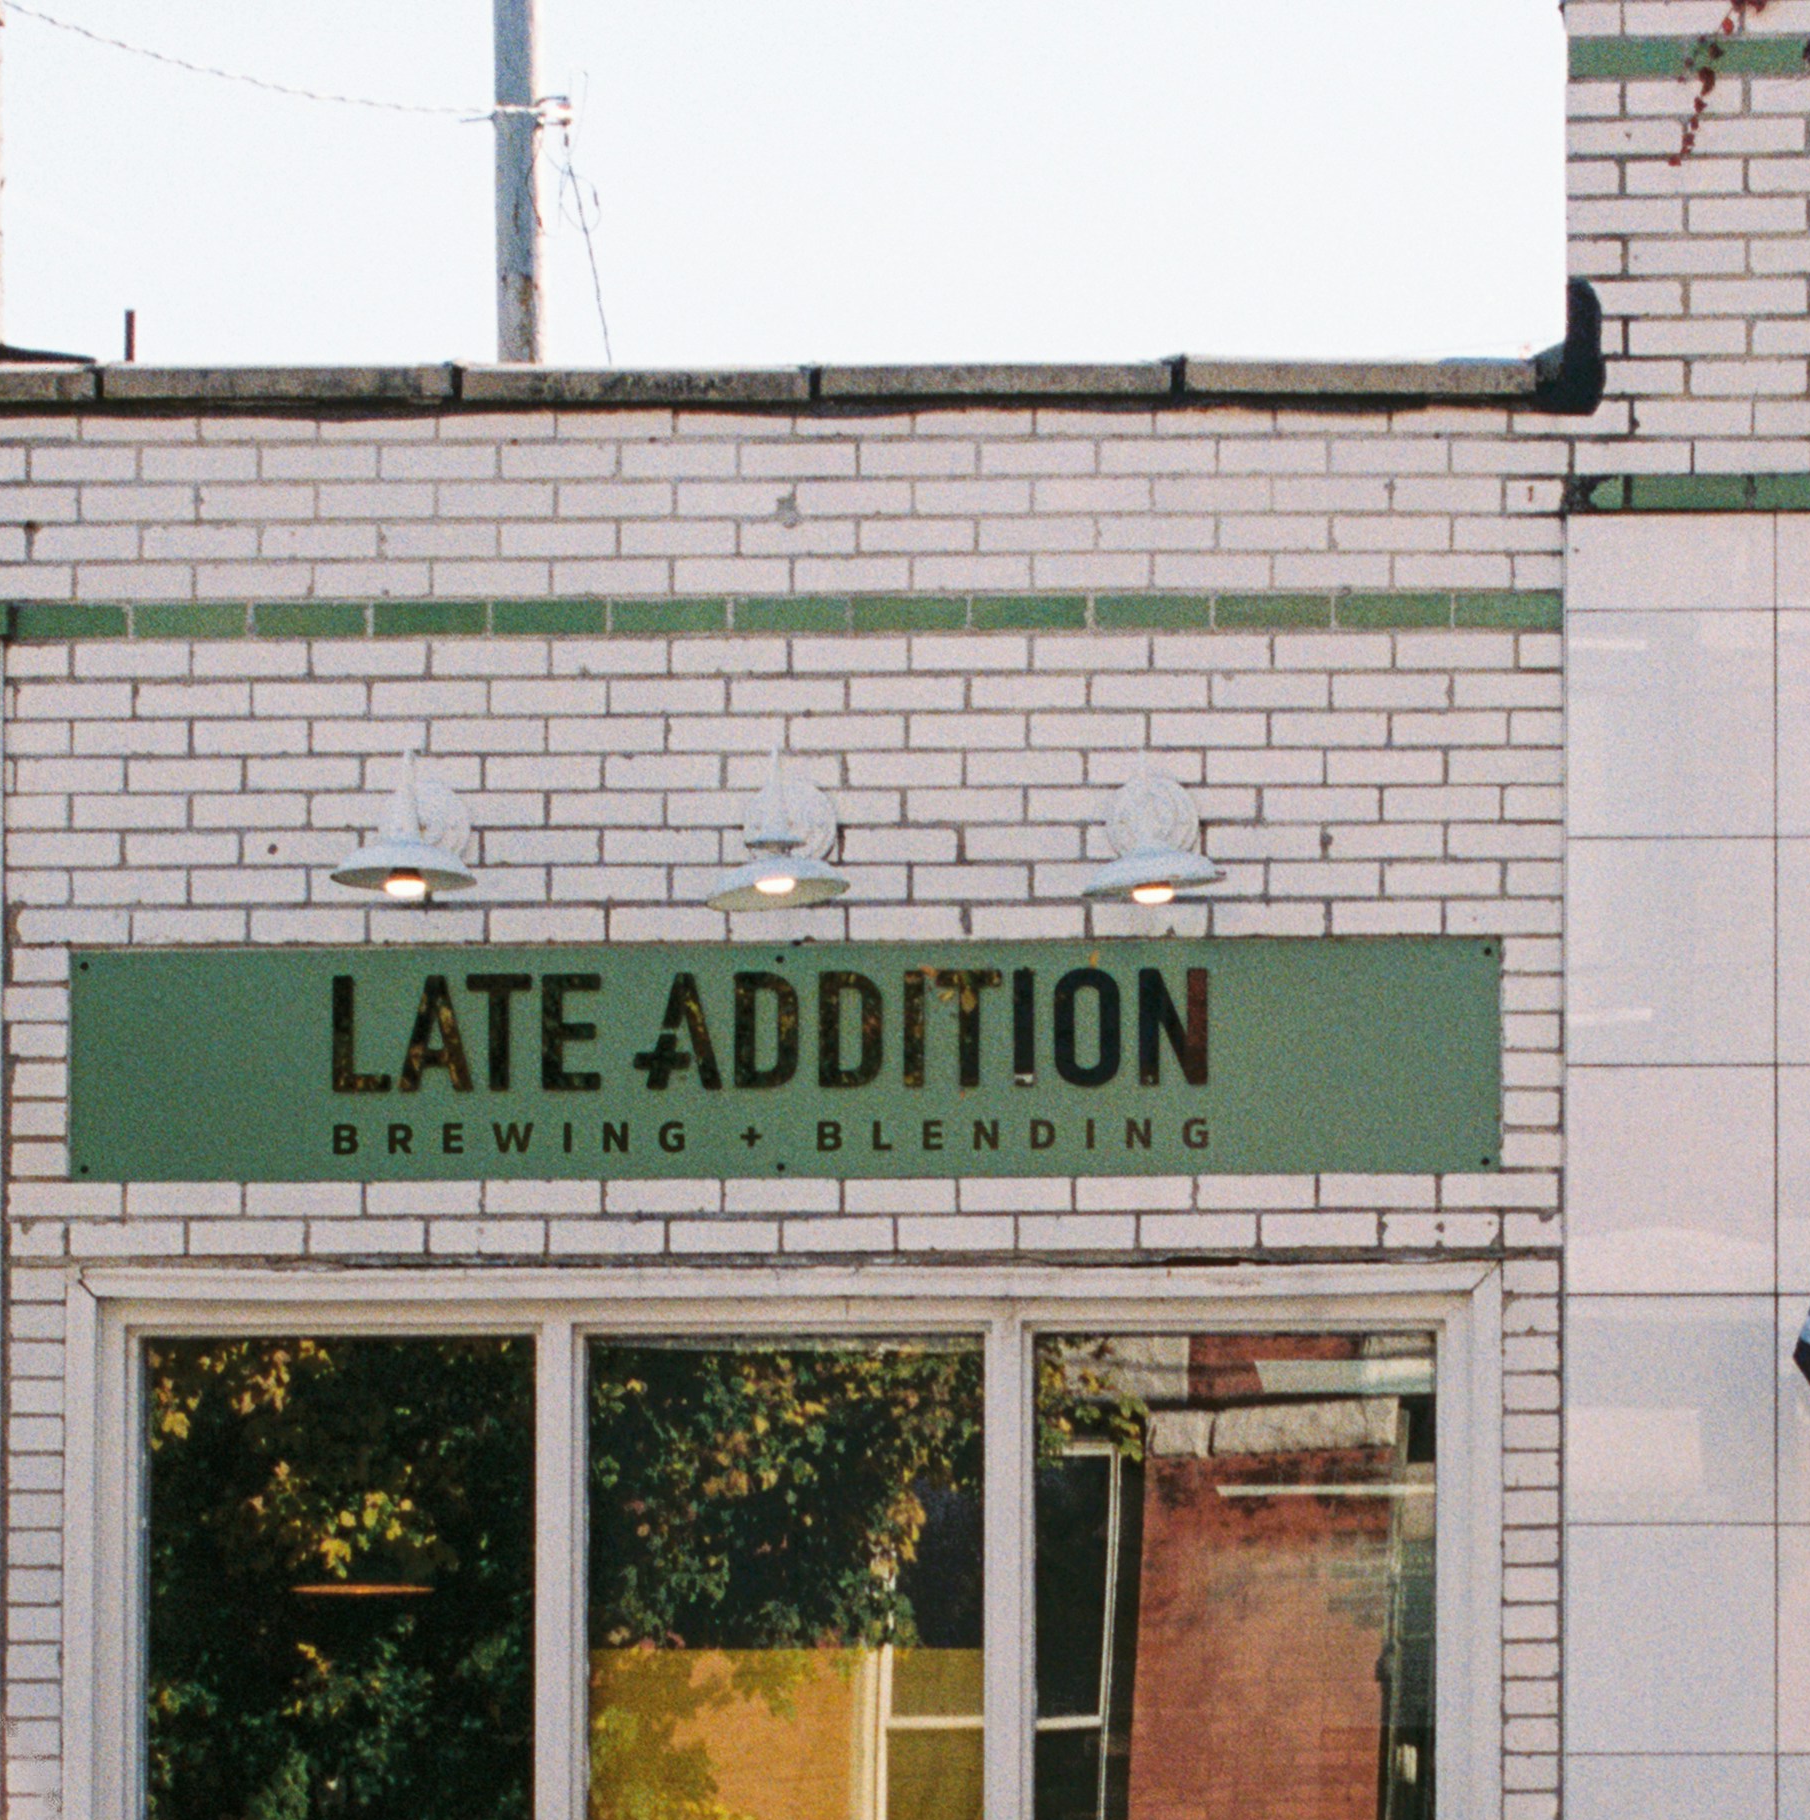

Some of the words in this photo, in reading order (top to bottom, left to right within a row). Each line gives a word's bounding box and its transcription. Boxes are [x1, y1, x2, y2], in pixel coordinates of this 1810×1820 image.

[332, 973, 601, 1092] LATE
[633, 966, 1209, 1091] ADDITION
[332, 1120, 687, 1156] BREWING
[816, 1117, 1210, 1152] BLENDING
